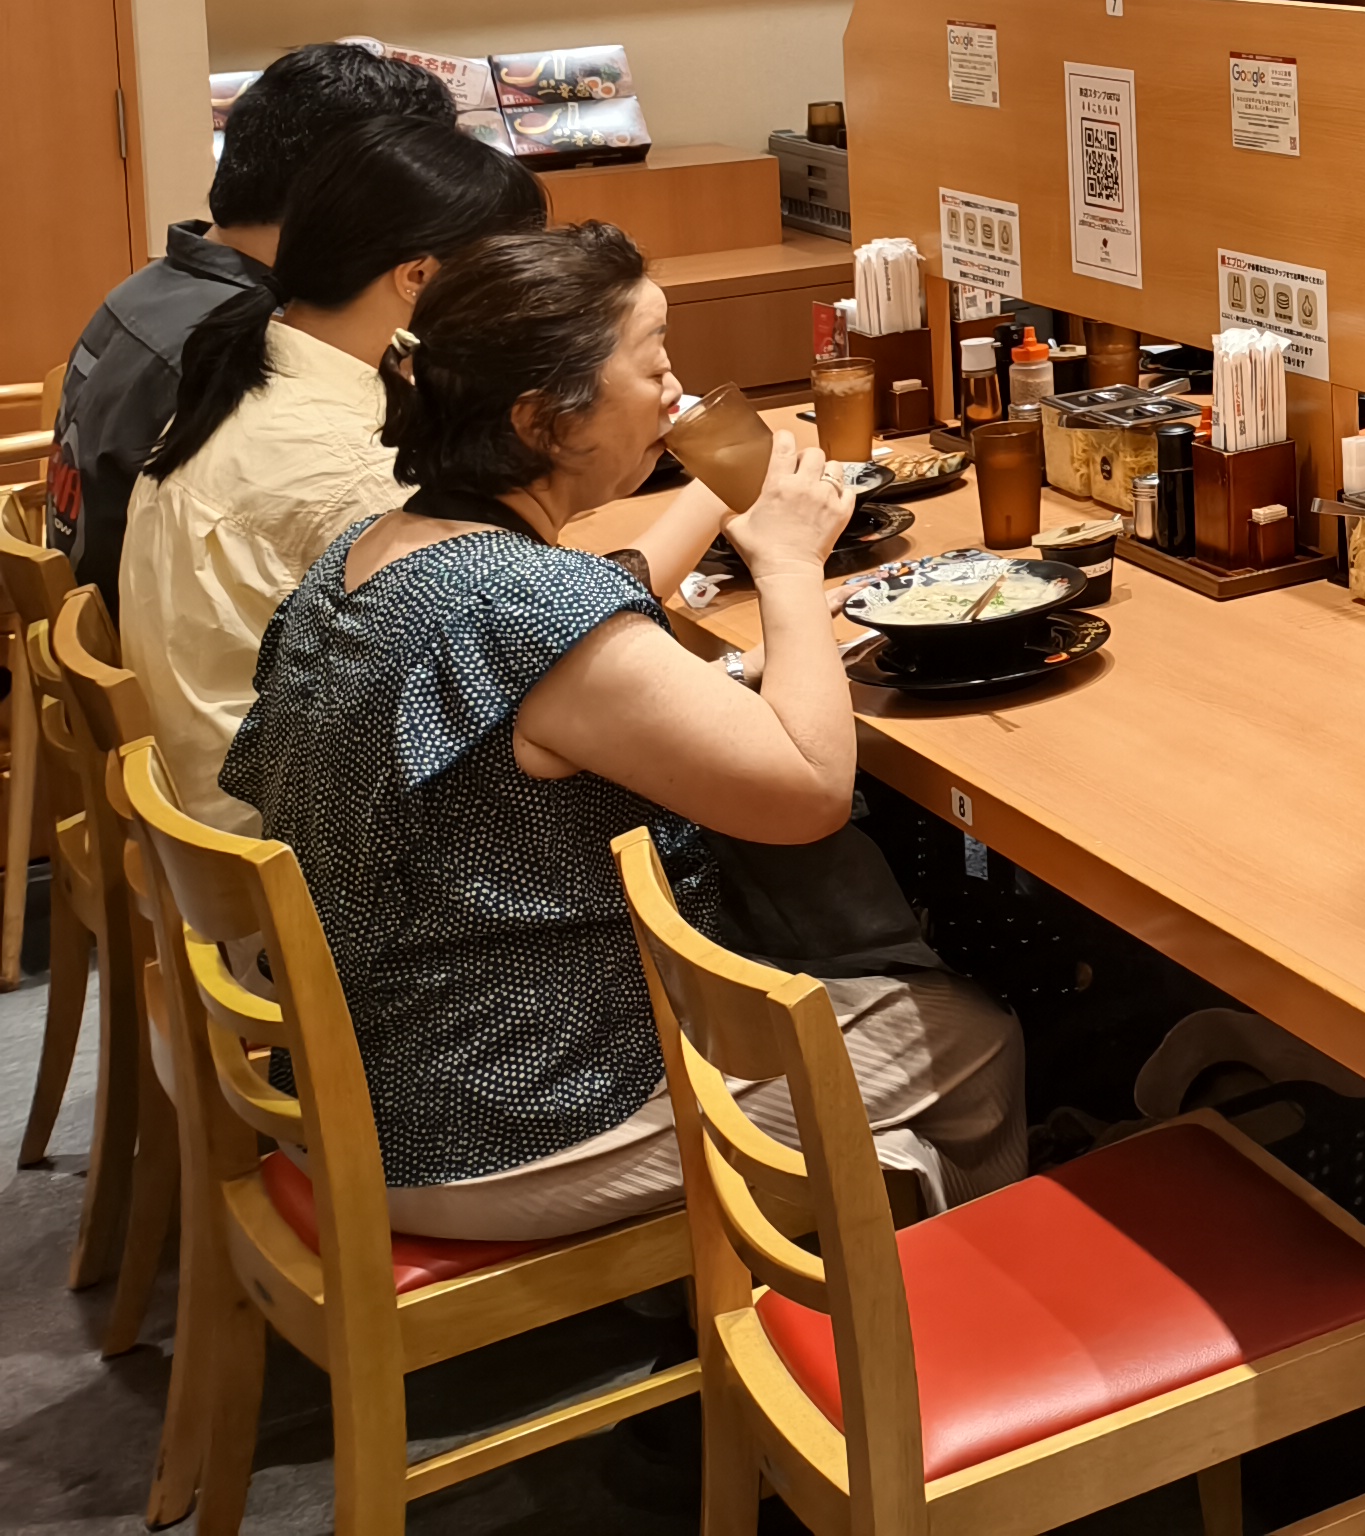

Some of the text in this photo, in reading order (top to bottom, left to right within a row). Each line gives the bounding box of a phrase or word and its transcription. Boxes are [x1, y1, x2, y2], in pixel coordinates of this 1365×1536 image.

[949, 29, 974, 50] Google
[1232, 63, 1266, 87] Google
[959, 796, 965, 817] 8
